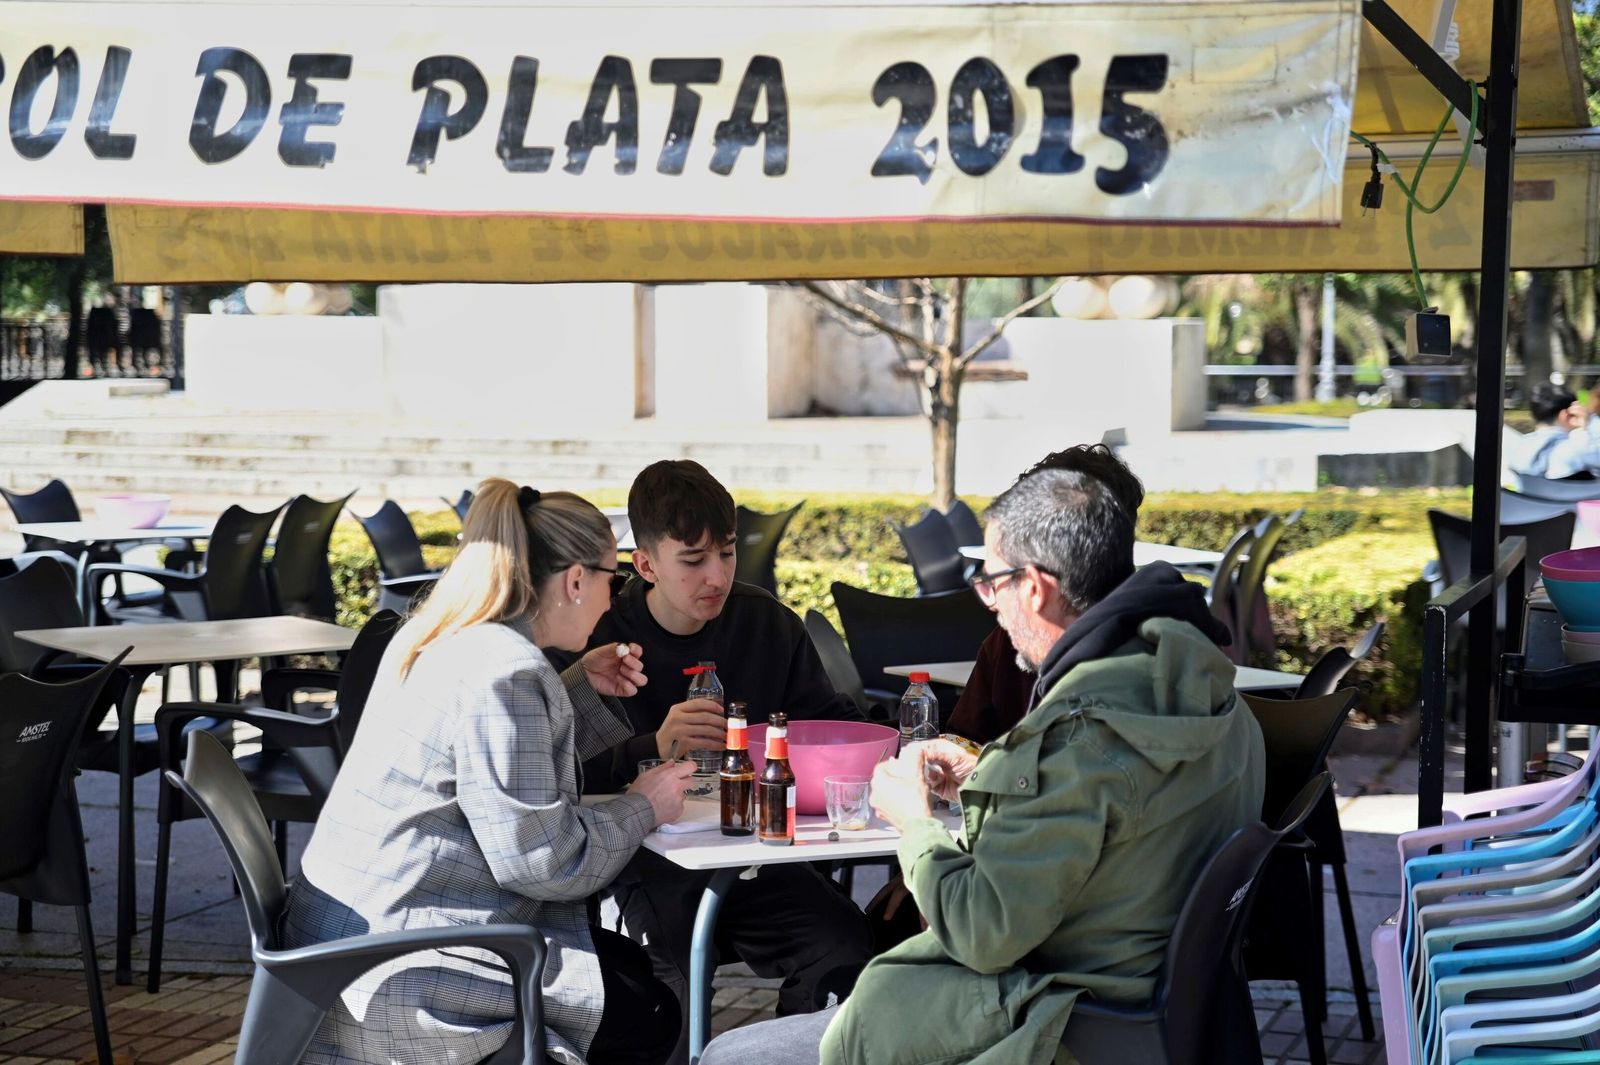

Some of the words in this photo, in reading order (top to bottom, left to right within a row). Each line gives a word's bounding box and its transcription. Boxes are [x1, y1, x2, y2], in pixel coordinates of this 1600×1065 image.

[0, 44, 137, 161] OL
[189, 46, 352, 168] DE
[407, 54, 790, 177] PLATA
[871, 53, 1170, 196] 2015
